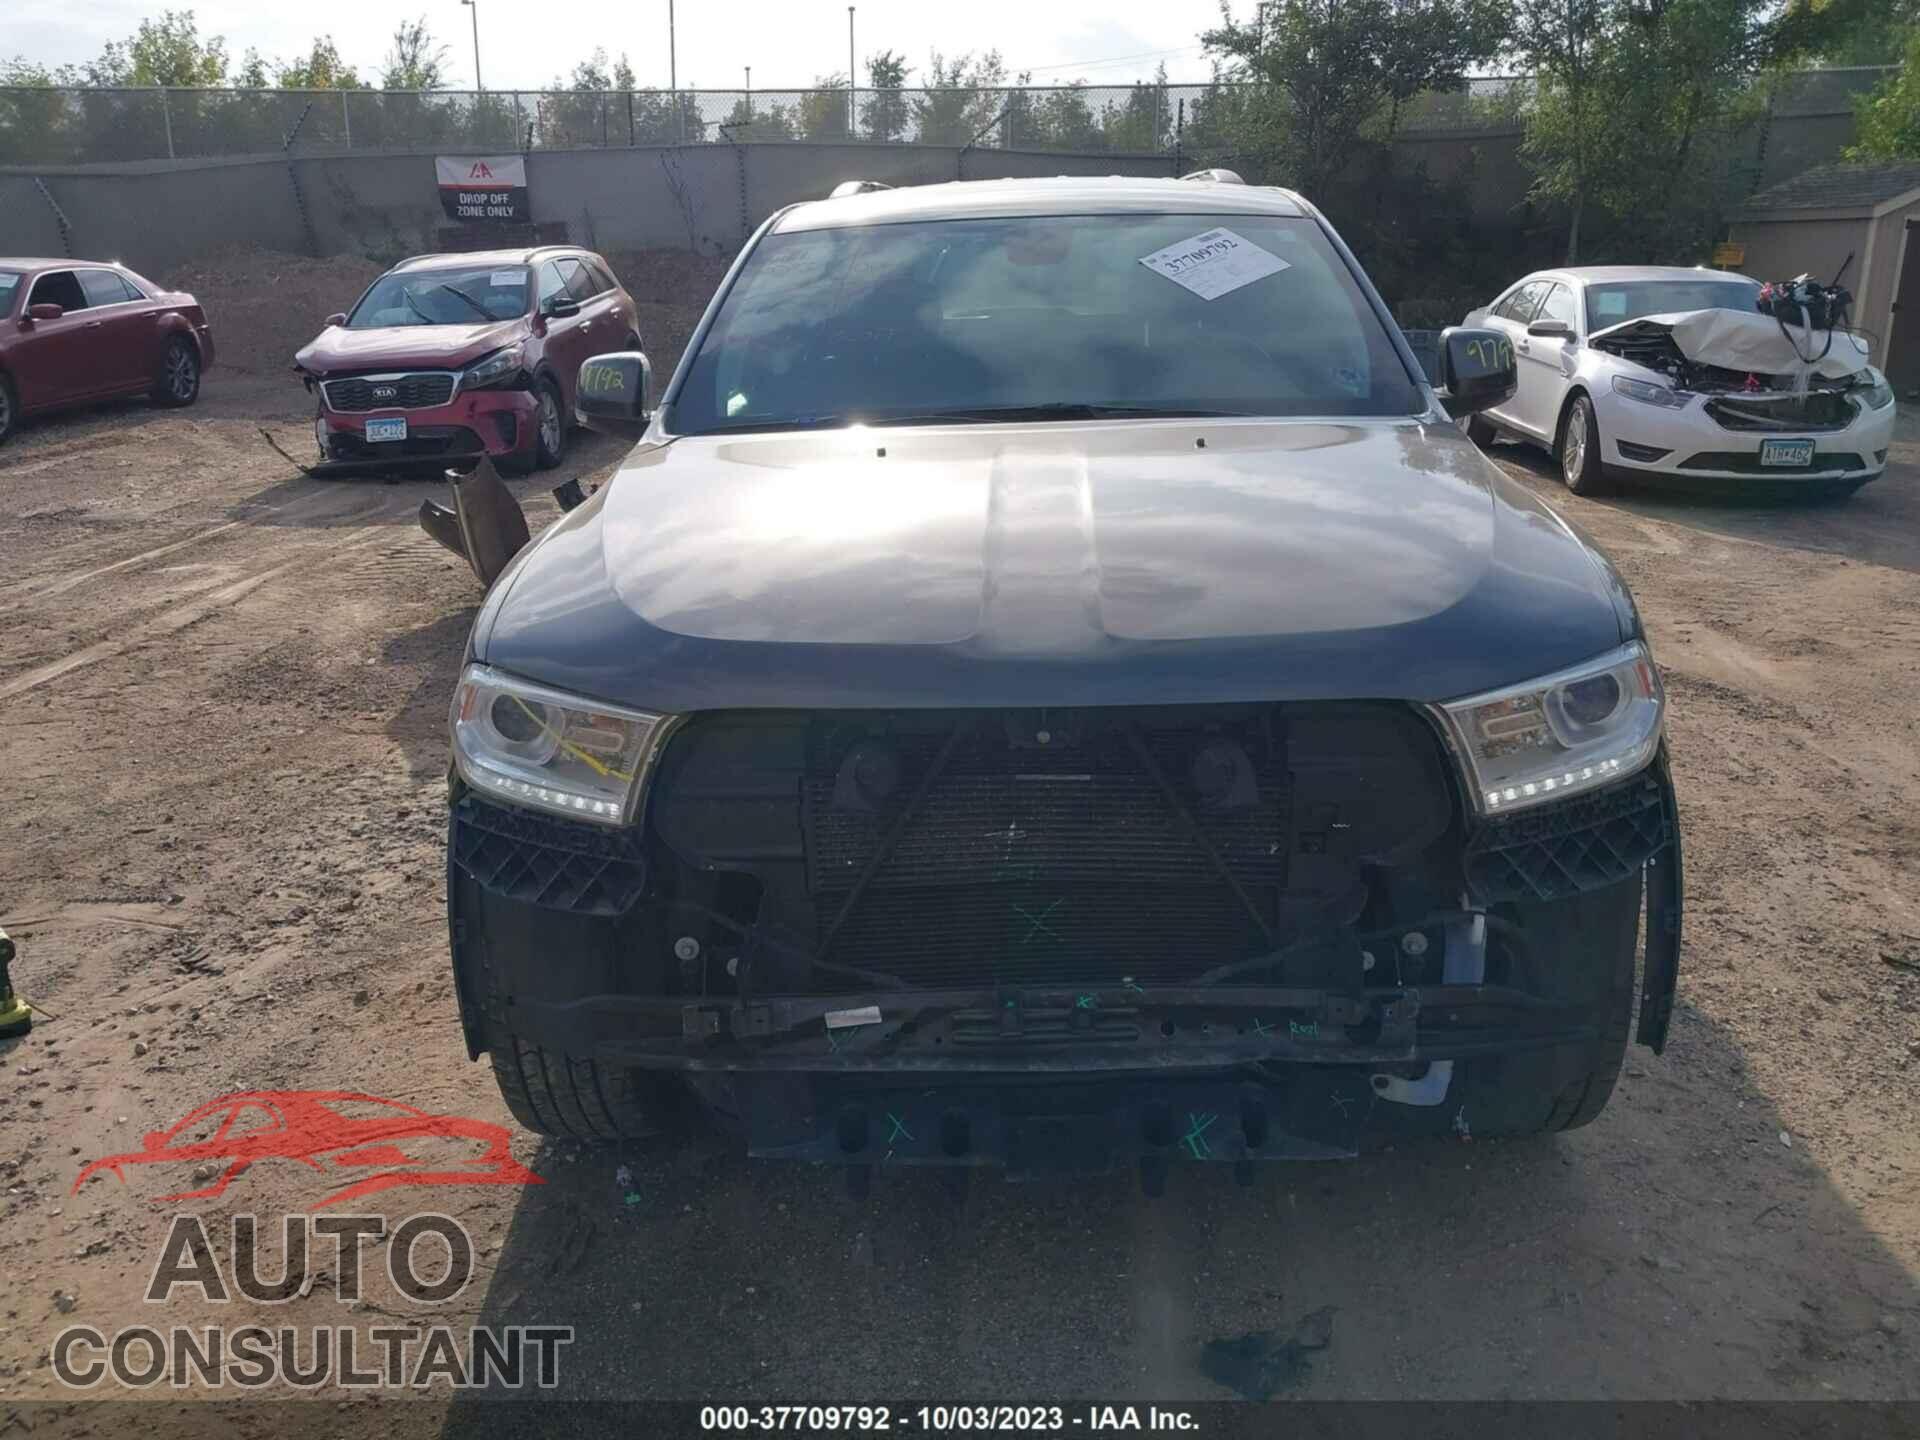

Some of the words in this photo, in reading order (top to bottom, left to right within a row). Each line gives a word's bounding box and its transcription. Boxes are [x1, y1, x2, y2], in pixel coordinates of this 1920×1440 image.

[459, 193, 488, 205] DROP
[490, 193, 509, 205] OFF
[457, 206, 485, 217] ZONE
[487, 206, 514, 217] ONLY
[1165, 239, 1239, 273] 37709792
